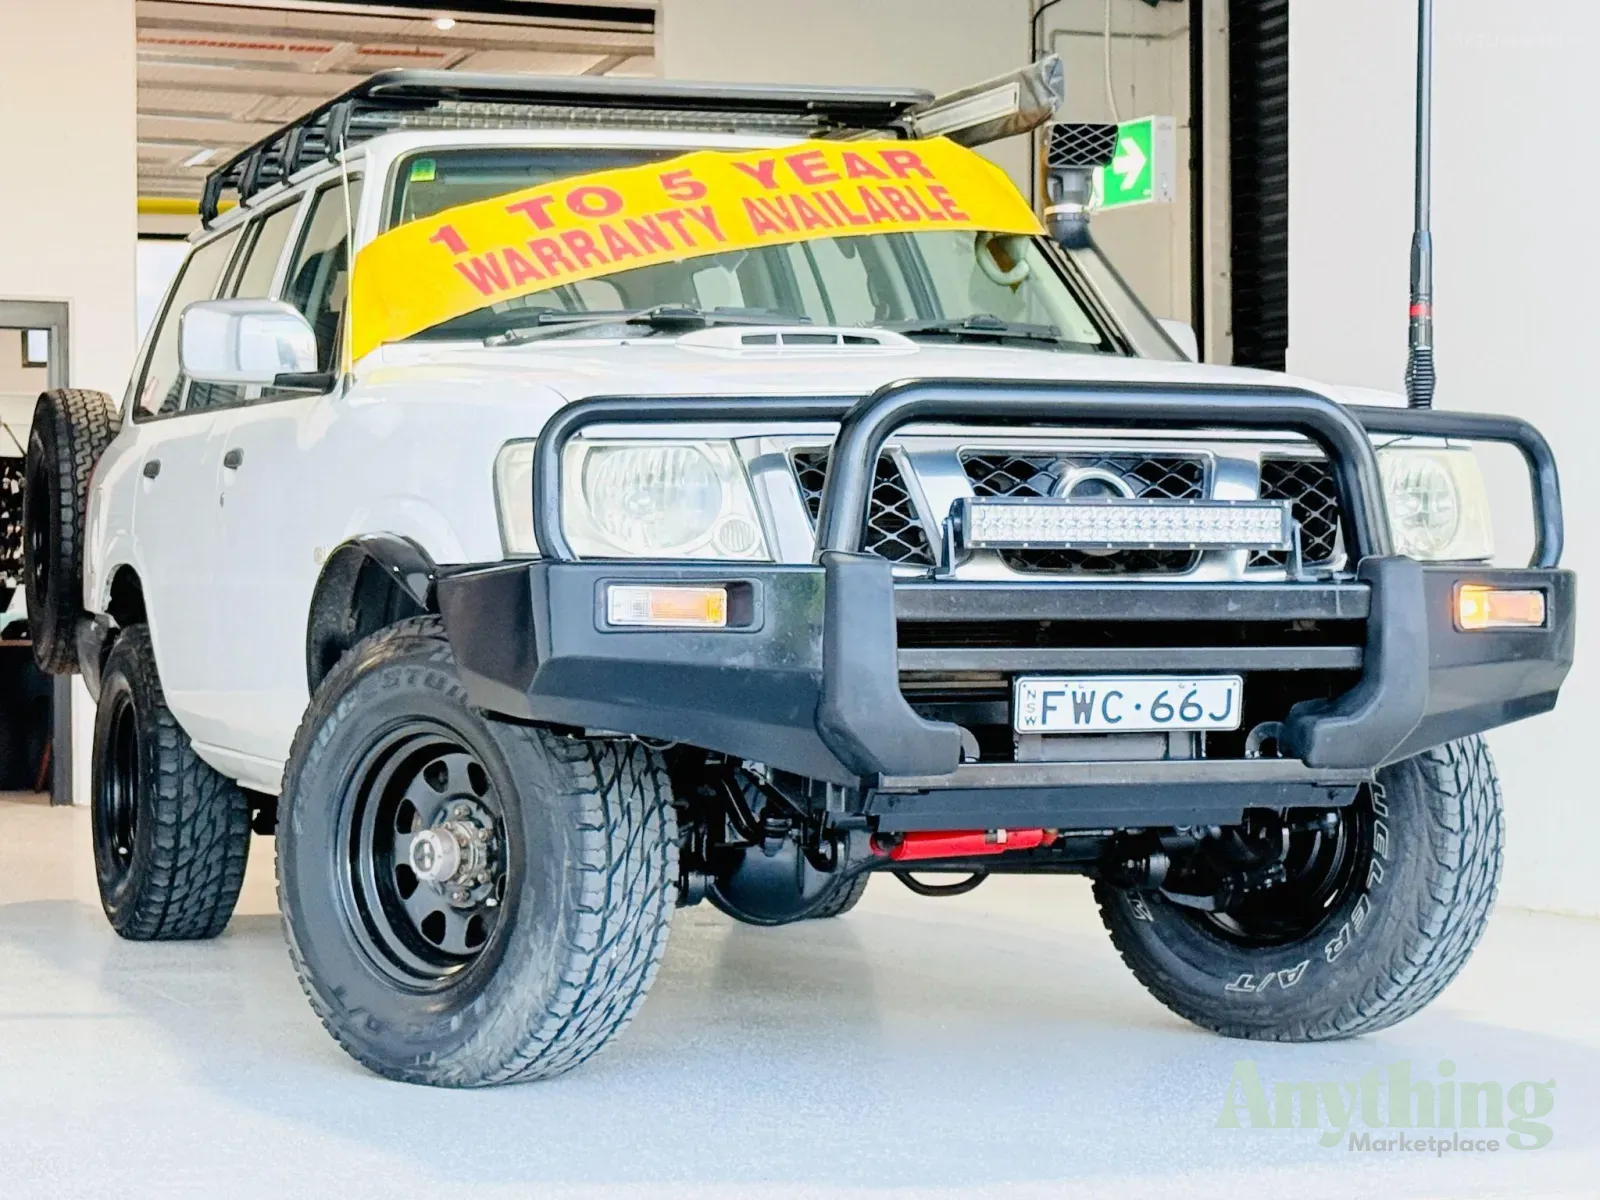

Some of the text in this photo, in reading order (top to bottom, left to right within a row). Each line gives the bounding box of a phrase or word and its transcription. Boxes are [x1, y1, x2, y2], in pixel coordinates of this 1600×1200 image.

[429, 150, 936, 255] 1 TO 5 YEAR
[454, 184, 970, 297] WARRANTY AVAILABLE
[1024, 689, 1037, 726] NSW
[1225, 780, 1391, 993] UELER A/T
